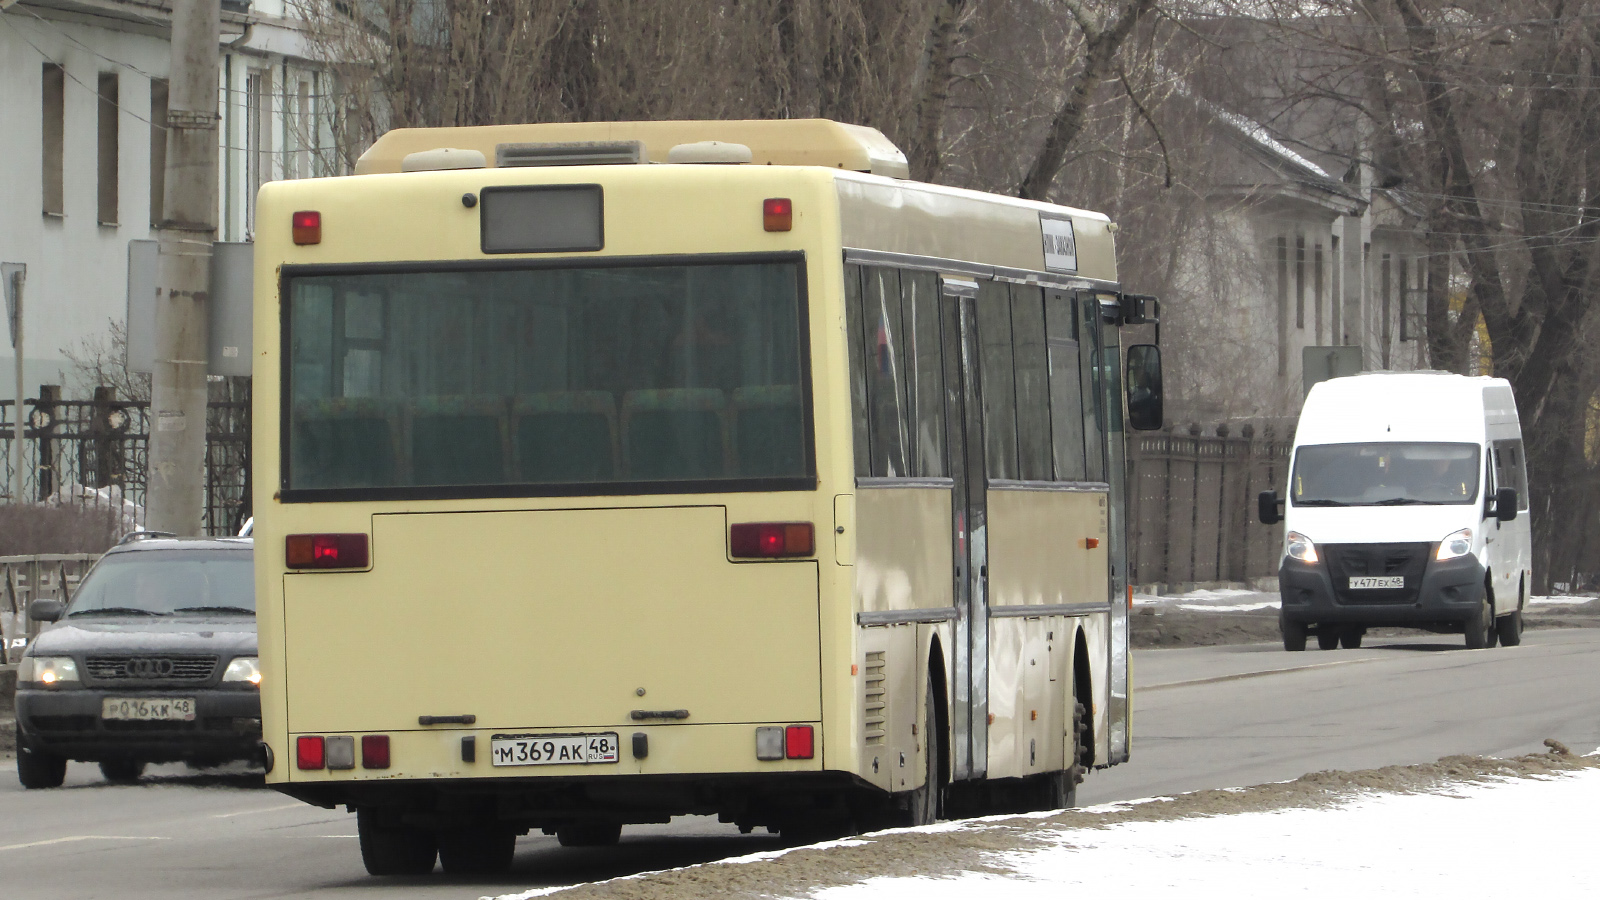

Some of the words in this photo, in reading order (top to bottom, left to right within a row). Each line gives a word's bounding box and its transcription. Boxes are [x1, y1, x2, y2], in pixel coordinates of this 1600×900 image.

[1353, 578, 1389, 588] У477ЕХ
[1391, 577, 1400, 585] 48
[174, 701, 189, 713] 48
[500, 741, 583, 763] М369АК
[589, 738, 609, 753] 48
